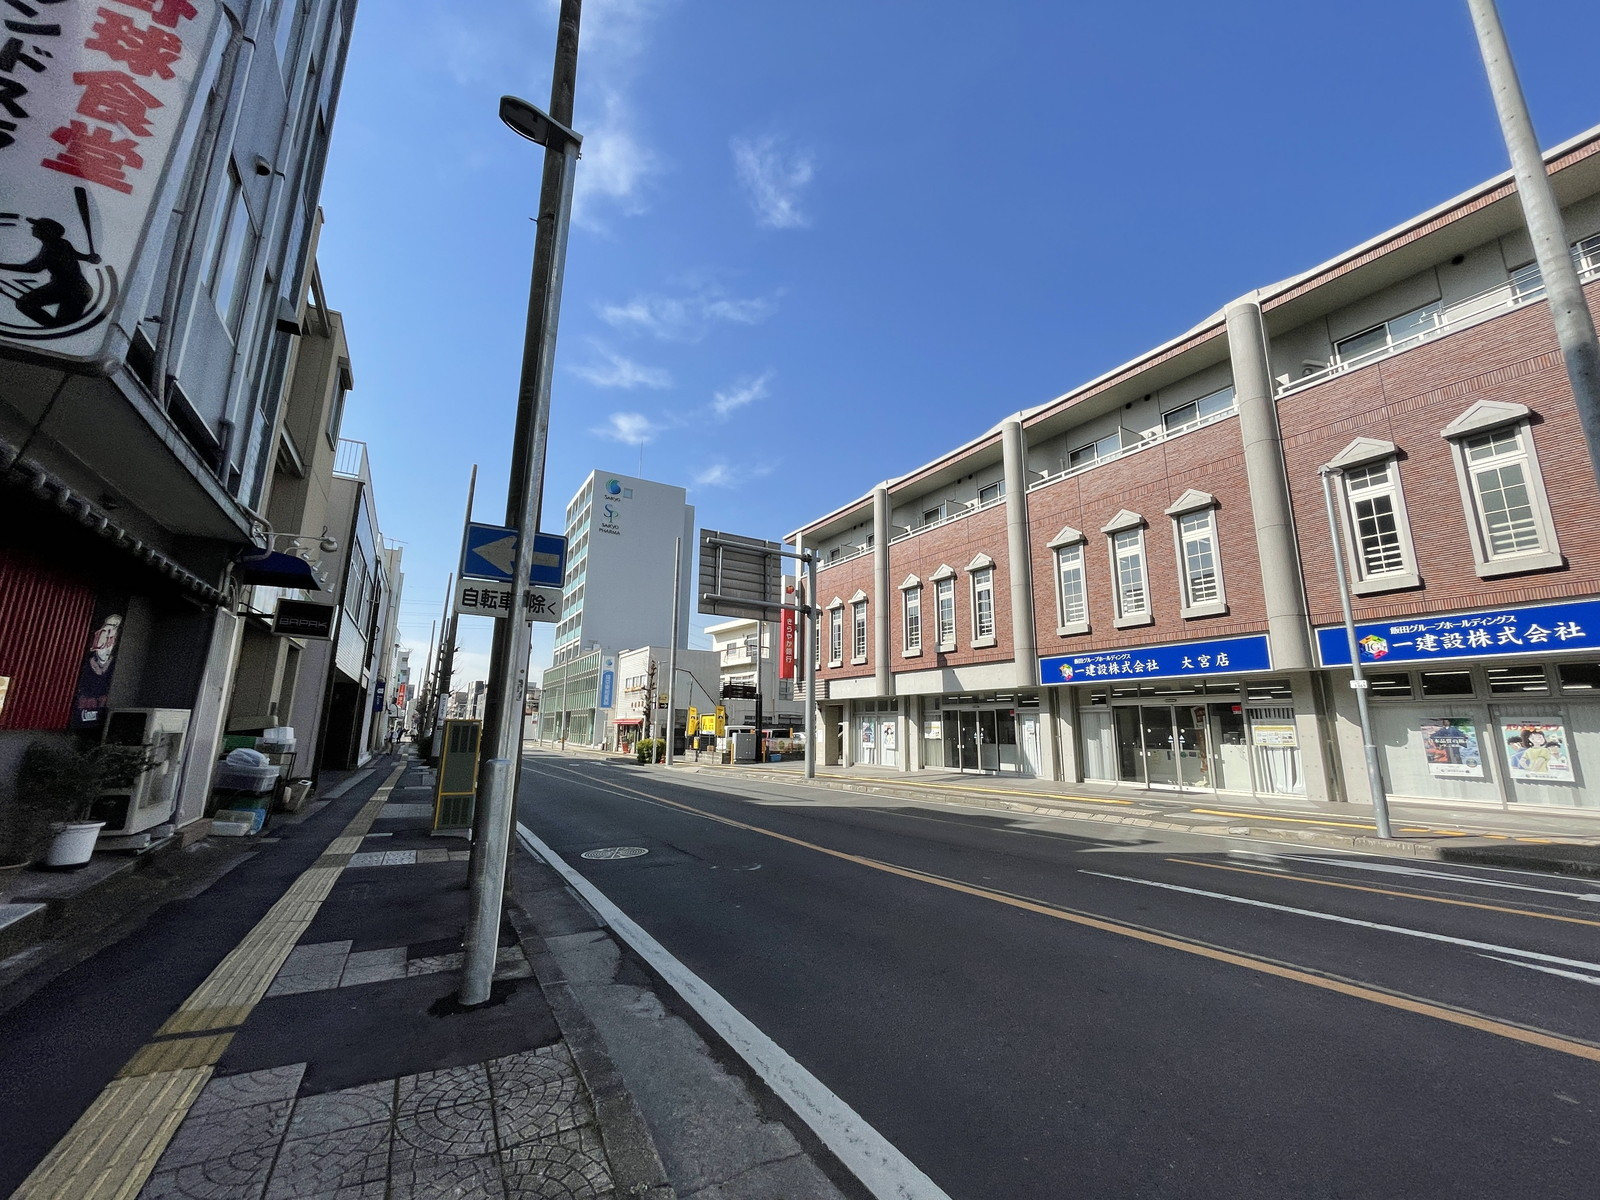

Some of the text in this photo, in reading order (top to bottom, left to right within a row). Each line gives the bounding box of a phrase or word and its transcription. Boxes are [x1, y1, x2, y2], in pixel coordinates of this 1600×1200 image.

[462, 587, 556, 615] 自転車除く
[1390, 615, 1517, 634] 飯田グループホールディングス
[1392, 621, 1587, 652] 一建設株式会社
[1074, 653, 1132, 664] 飯田グループホールディングス
[1075, 652, 1230, 676] 一建設株式会社 大宮店
